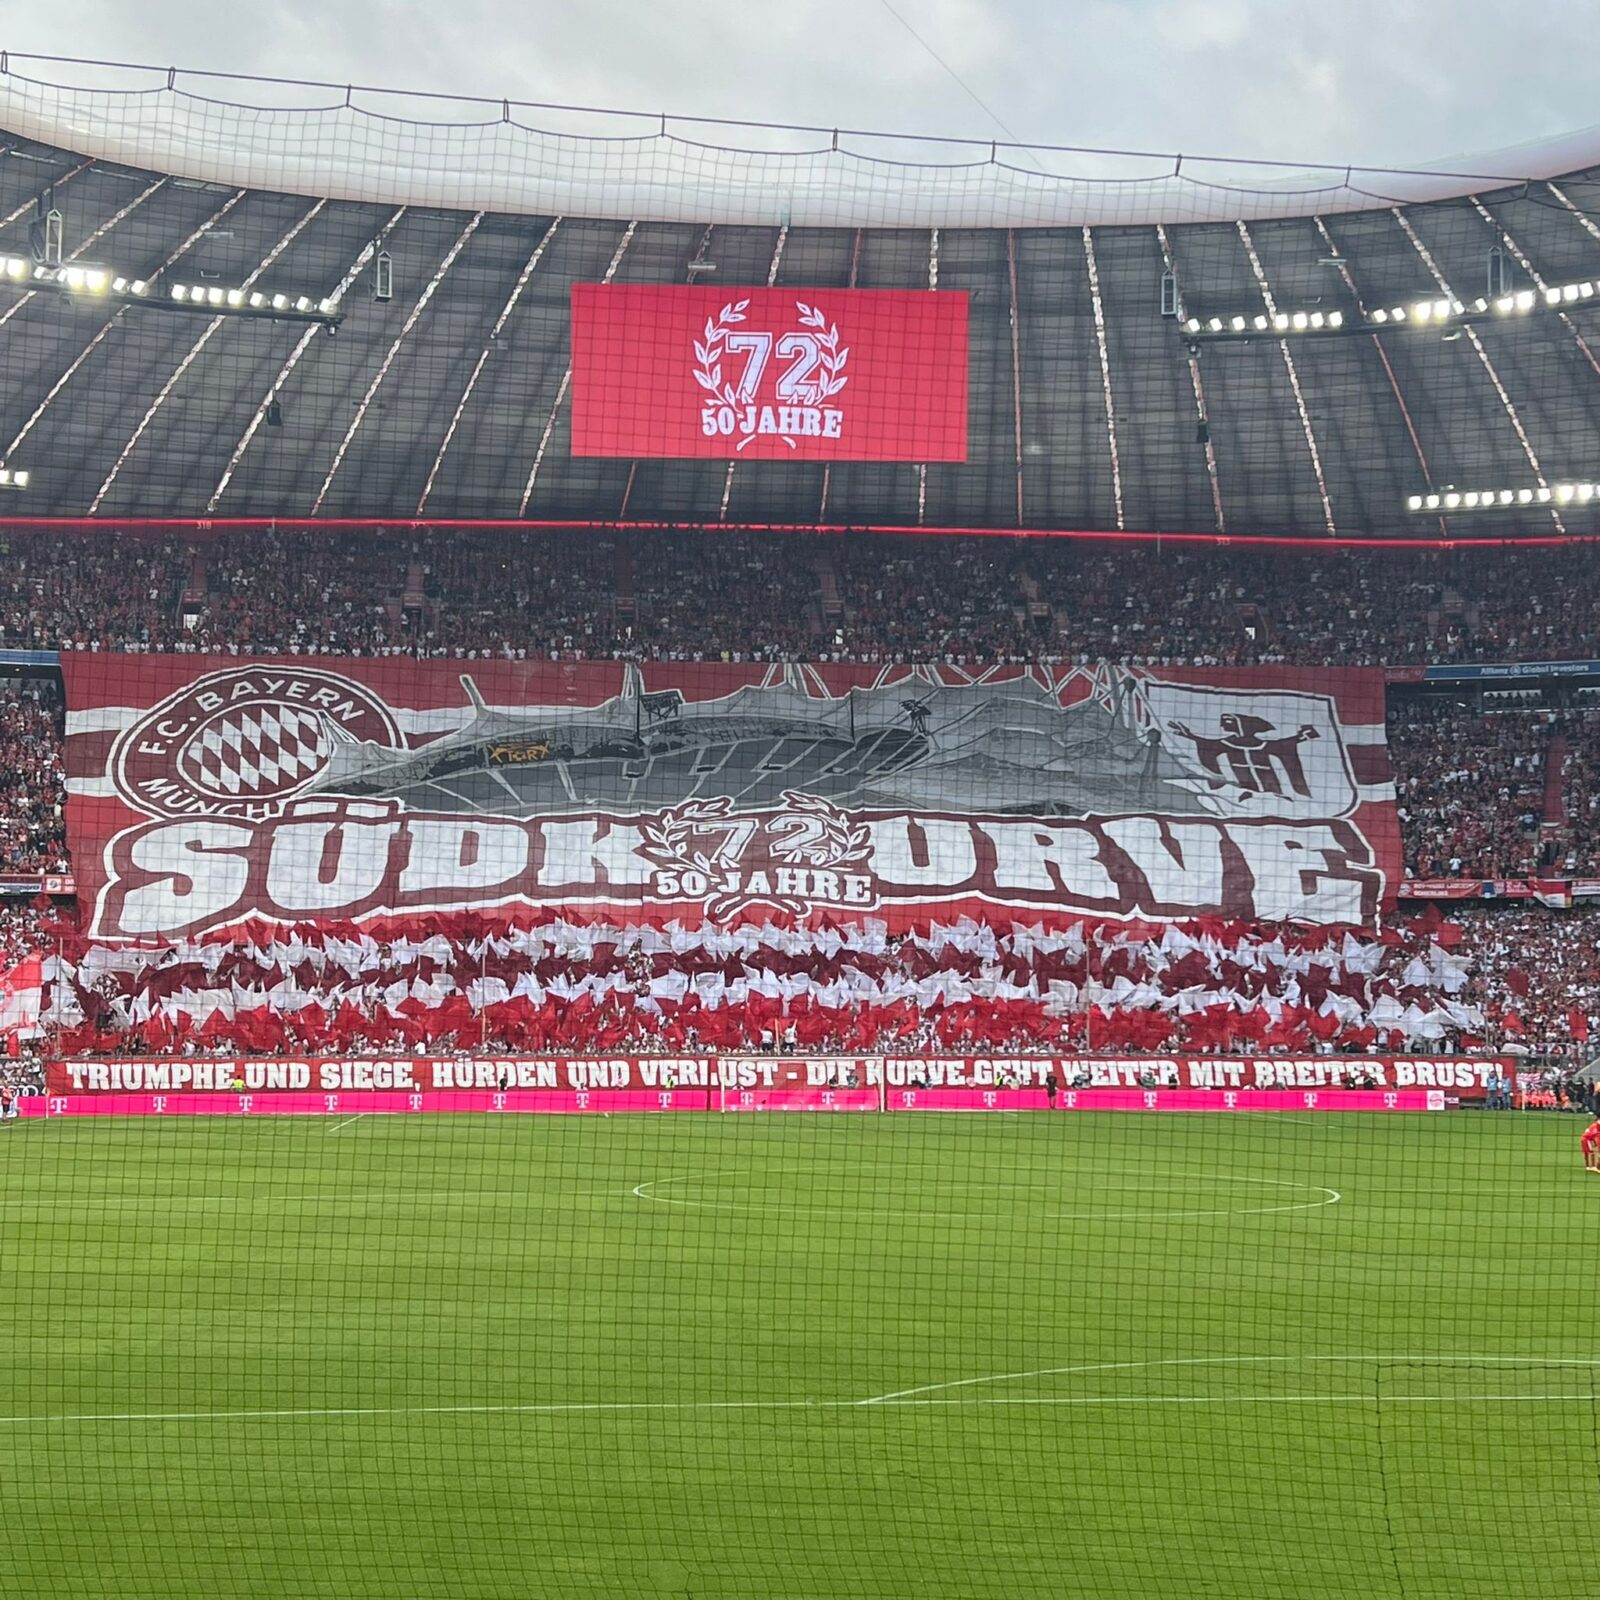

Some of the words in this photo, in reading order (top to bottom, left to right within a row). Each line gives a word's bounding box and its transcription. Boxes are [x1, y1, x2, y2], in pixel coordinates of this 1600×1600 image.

[725, 332, 821, 400] 72
[701, 406, 736, 436] 50
[740, 405, 844, 438] JAHRE
[1522, 664, 1549, 674] Global
[195, 677, 366, 722] BAYERN
[692, 813, 832, 864] 72
[656, 870, 707, 896] 50
[717, 866, 872, 903] JAHRE
[66, 1062, 236, 1090] TRIUMPHE
[245, 1062, 310, 1090] UND
[320, 1061, 421, 1091] SIEGE,
[432, 1058, 557, 1088] HÜRDEN
[567, 1060, 631, 1088] UND
[638, 1059, 778, 1087] VERLUST
[805, 1060, 856, 1086] DIE
[865, 1059, 966, 1086] KURVE
[974, 1060, 1053, 1086] GEHT
[1060, 1060, 1181, 1087] WEITER
[1188, 1060, 1246, 1086] MIT
[1253, 1060, 1388, 1087] BREITER
